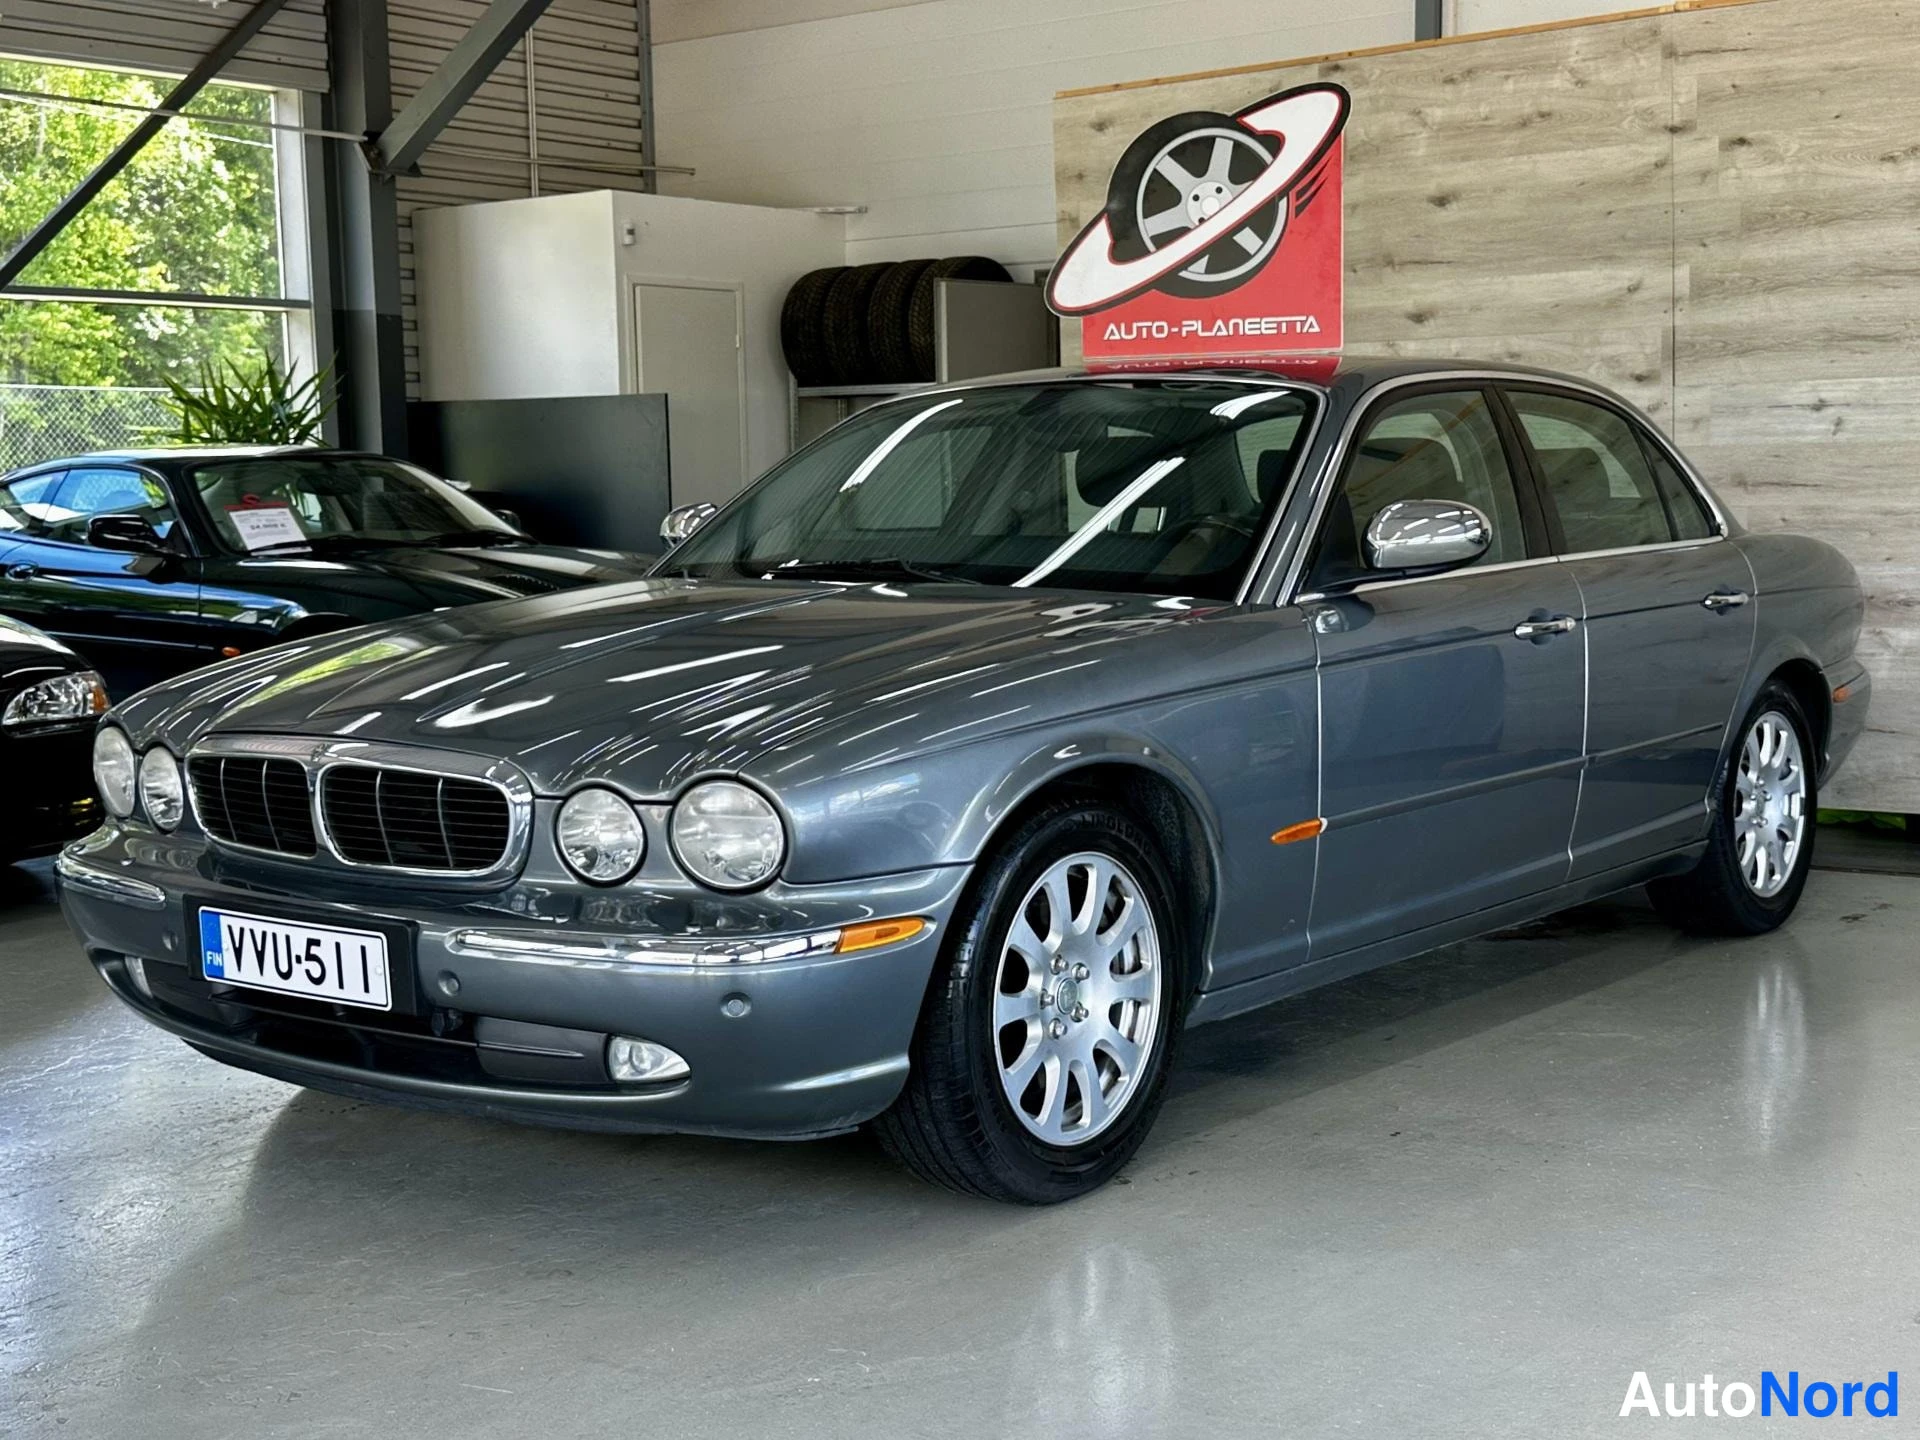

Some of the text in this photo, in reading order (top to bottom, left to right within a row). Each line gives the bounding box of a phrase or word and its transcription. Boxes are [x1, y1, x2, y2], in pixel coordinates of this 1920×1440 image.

[1103, 315, 1321, 341] AUTO-PLANEETTA
[206, 951, 223, 968] FIN
[227, 924, 370, 994] VVU-511
